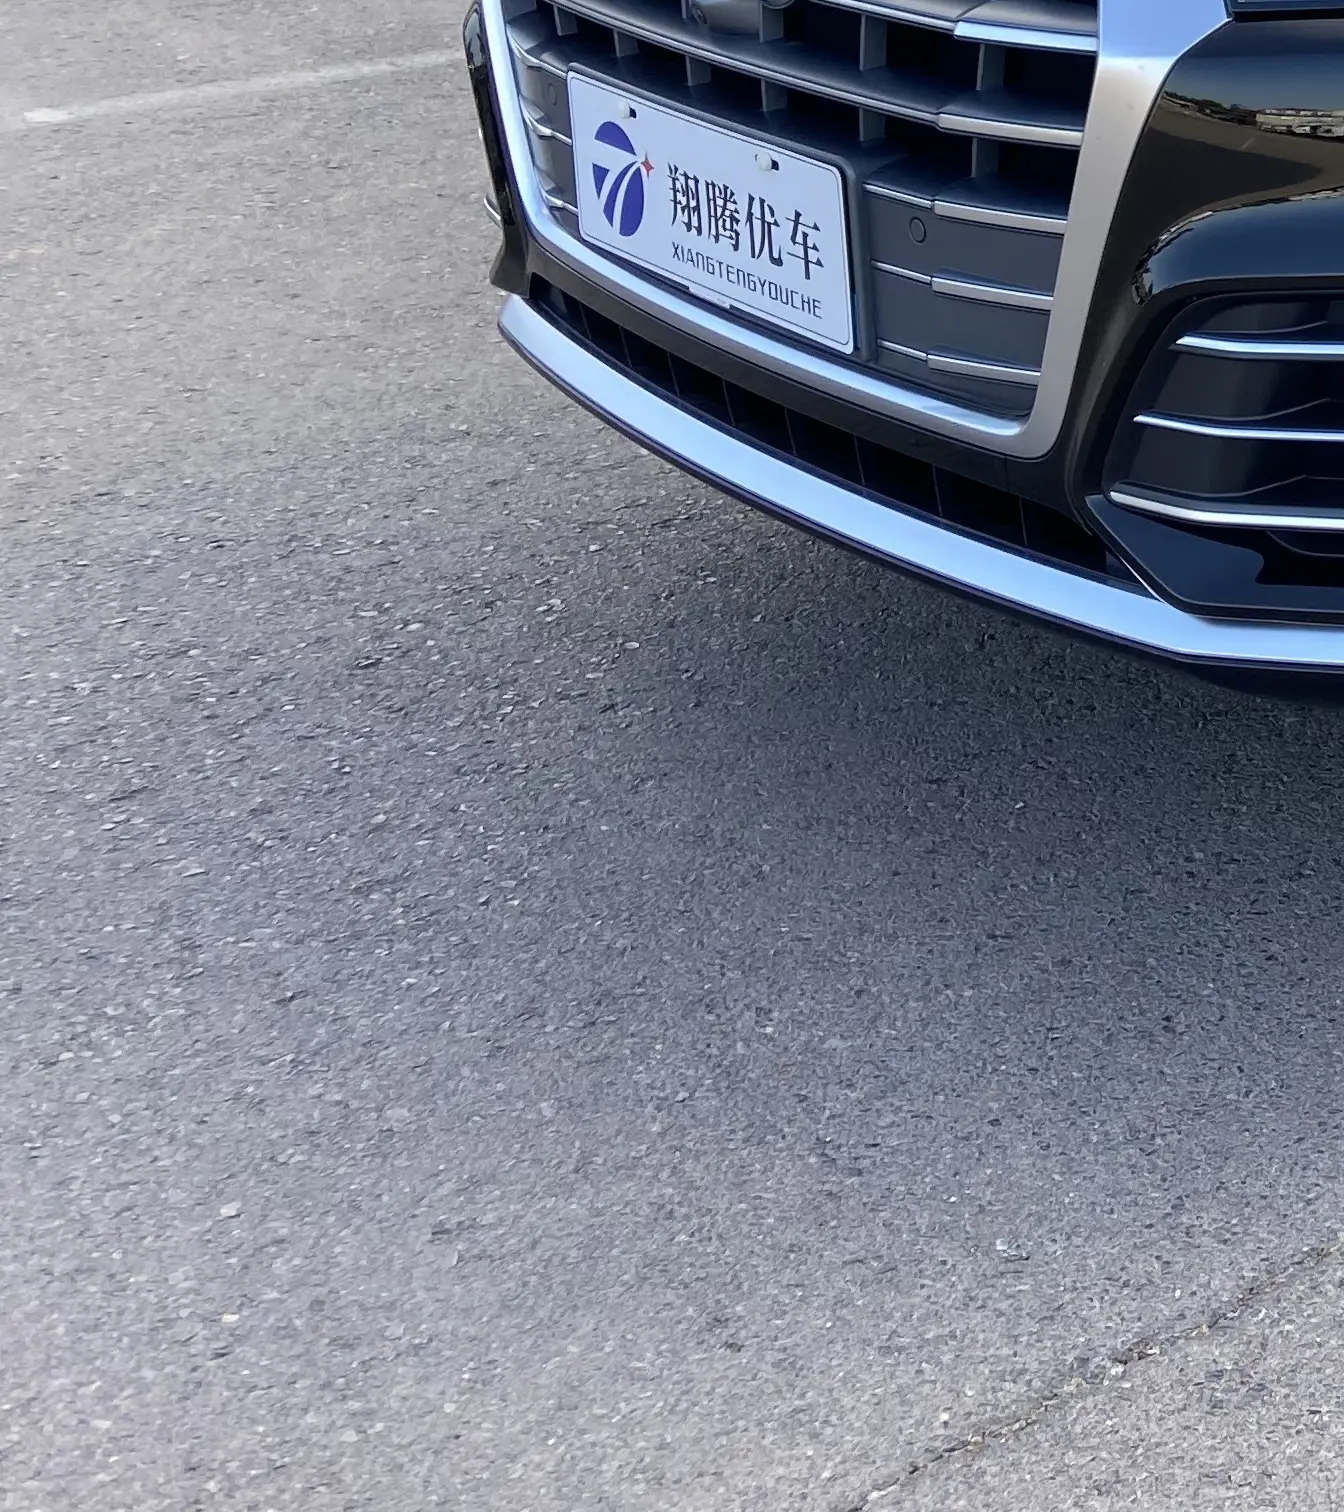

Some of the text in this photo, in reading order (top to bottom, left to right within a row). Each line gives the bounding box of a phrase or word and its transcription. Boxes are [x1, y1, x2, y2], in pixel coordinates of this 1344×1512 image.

[667, 161, 825, 281] 翔腾优车
[671, 241, 823, 320] XIANGTENGYOUCHE
